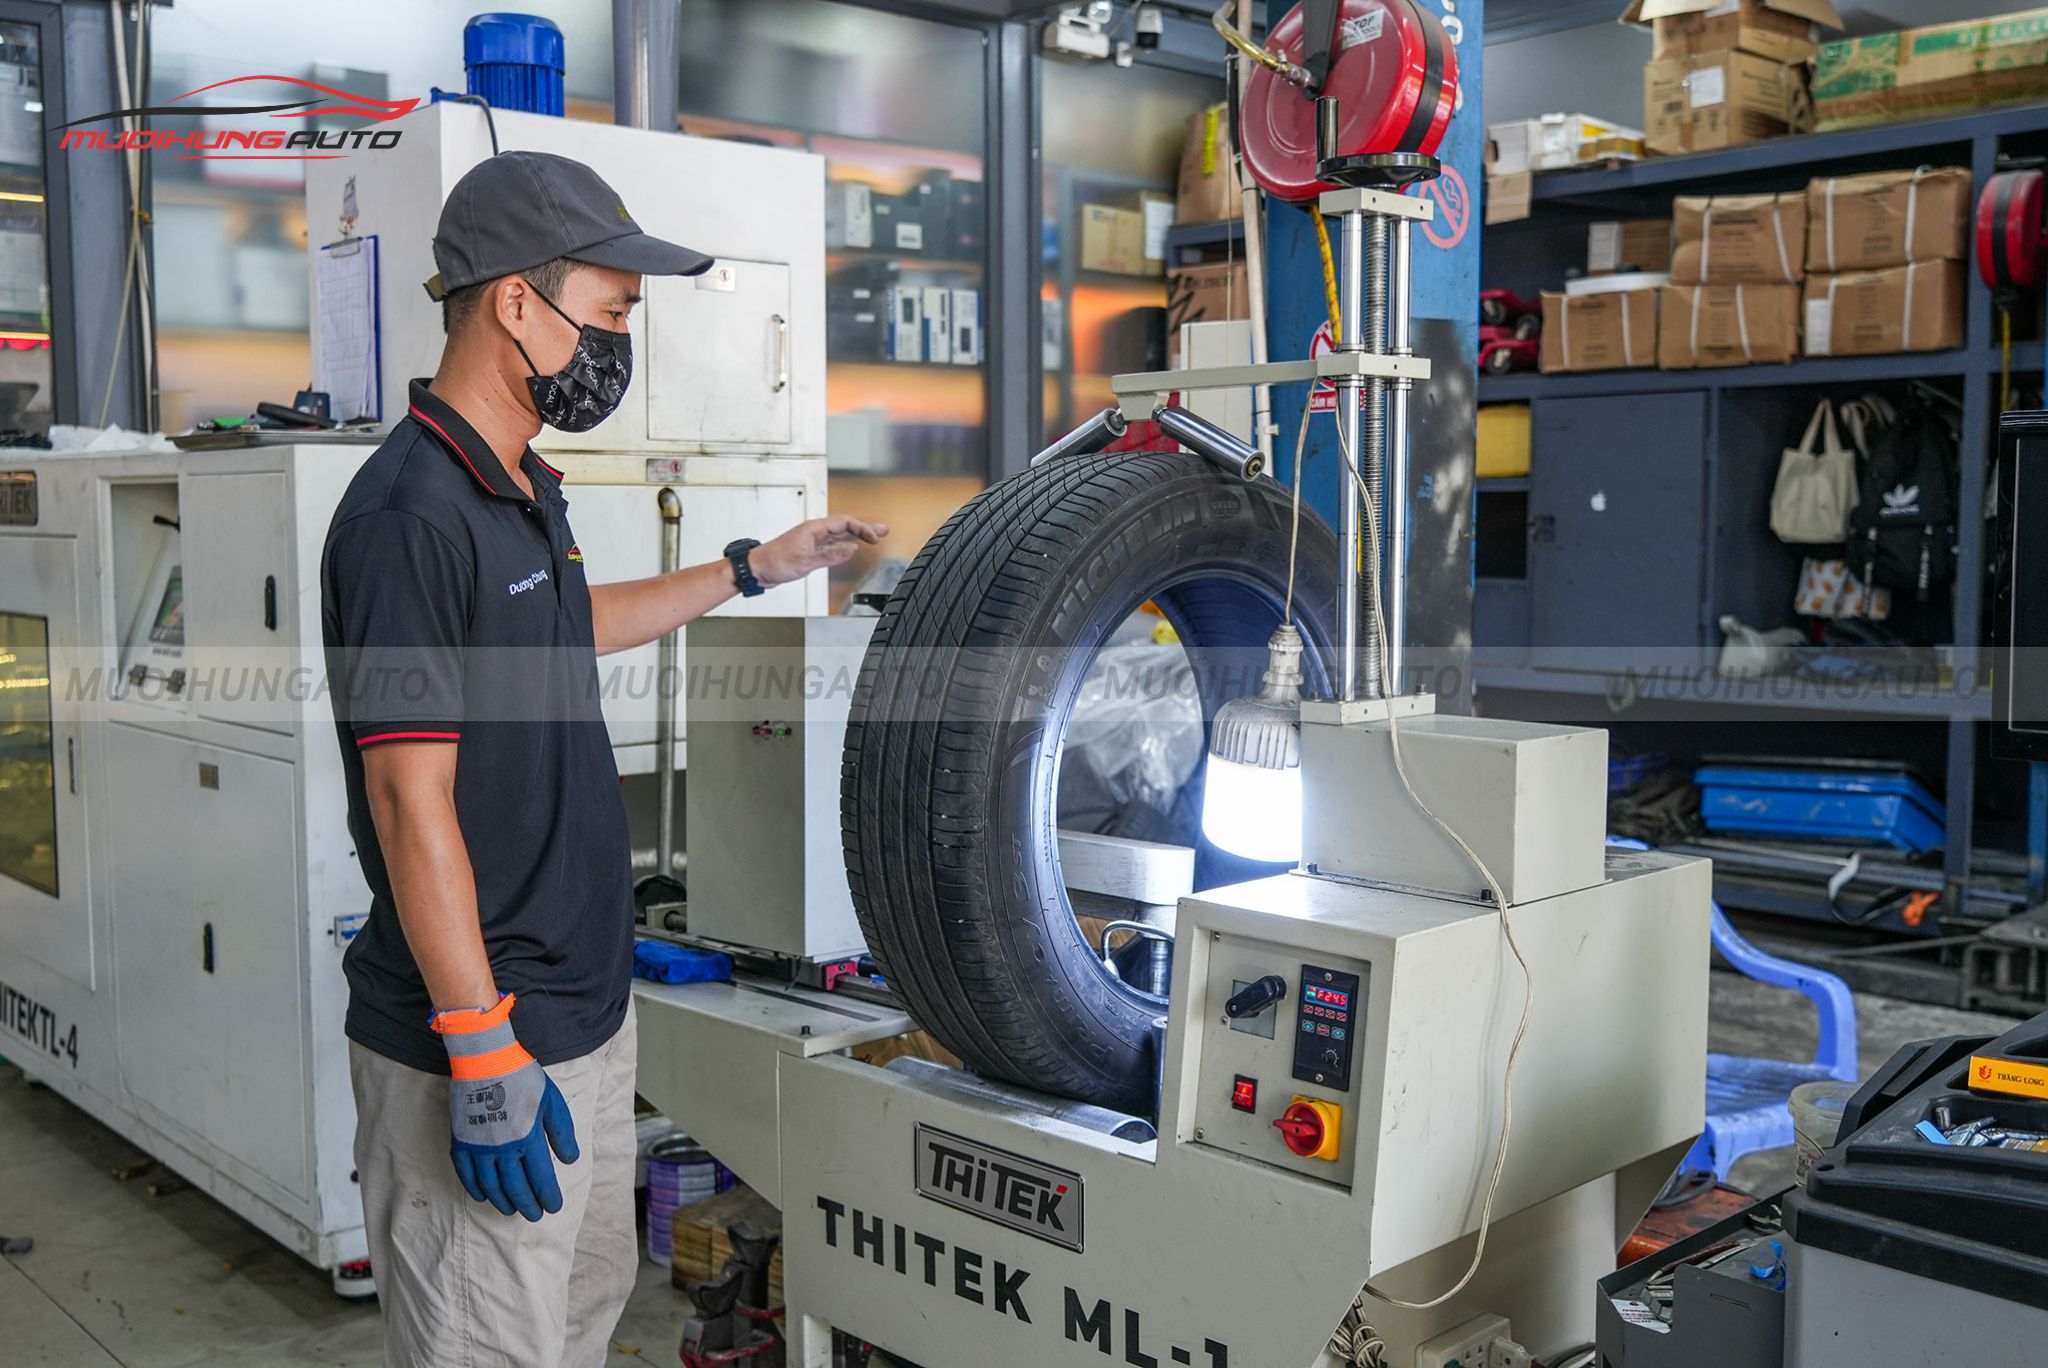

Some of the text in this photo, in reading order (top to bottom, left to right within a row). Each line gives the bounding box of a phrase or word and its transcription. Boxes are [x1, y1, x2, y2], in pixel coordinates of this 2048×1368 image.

[1051, 489, 1199, 642] MICHELIN
[2023, 1077, 2045, 1087] LONG
[816, 1195, 1033, 1325] THITEK
